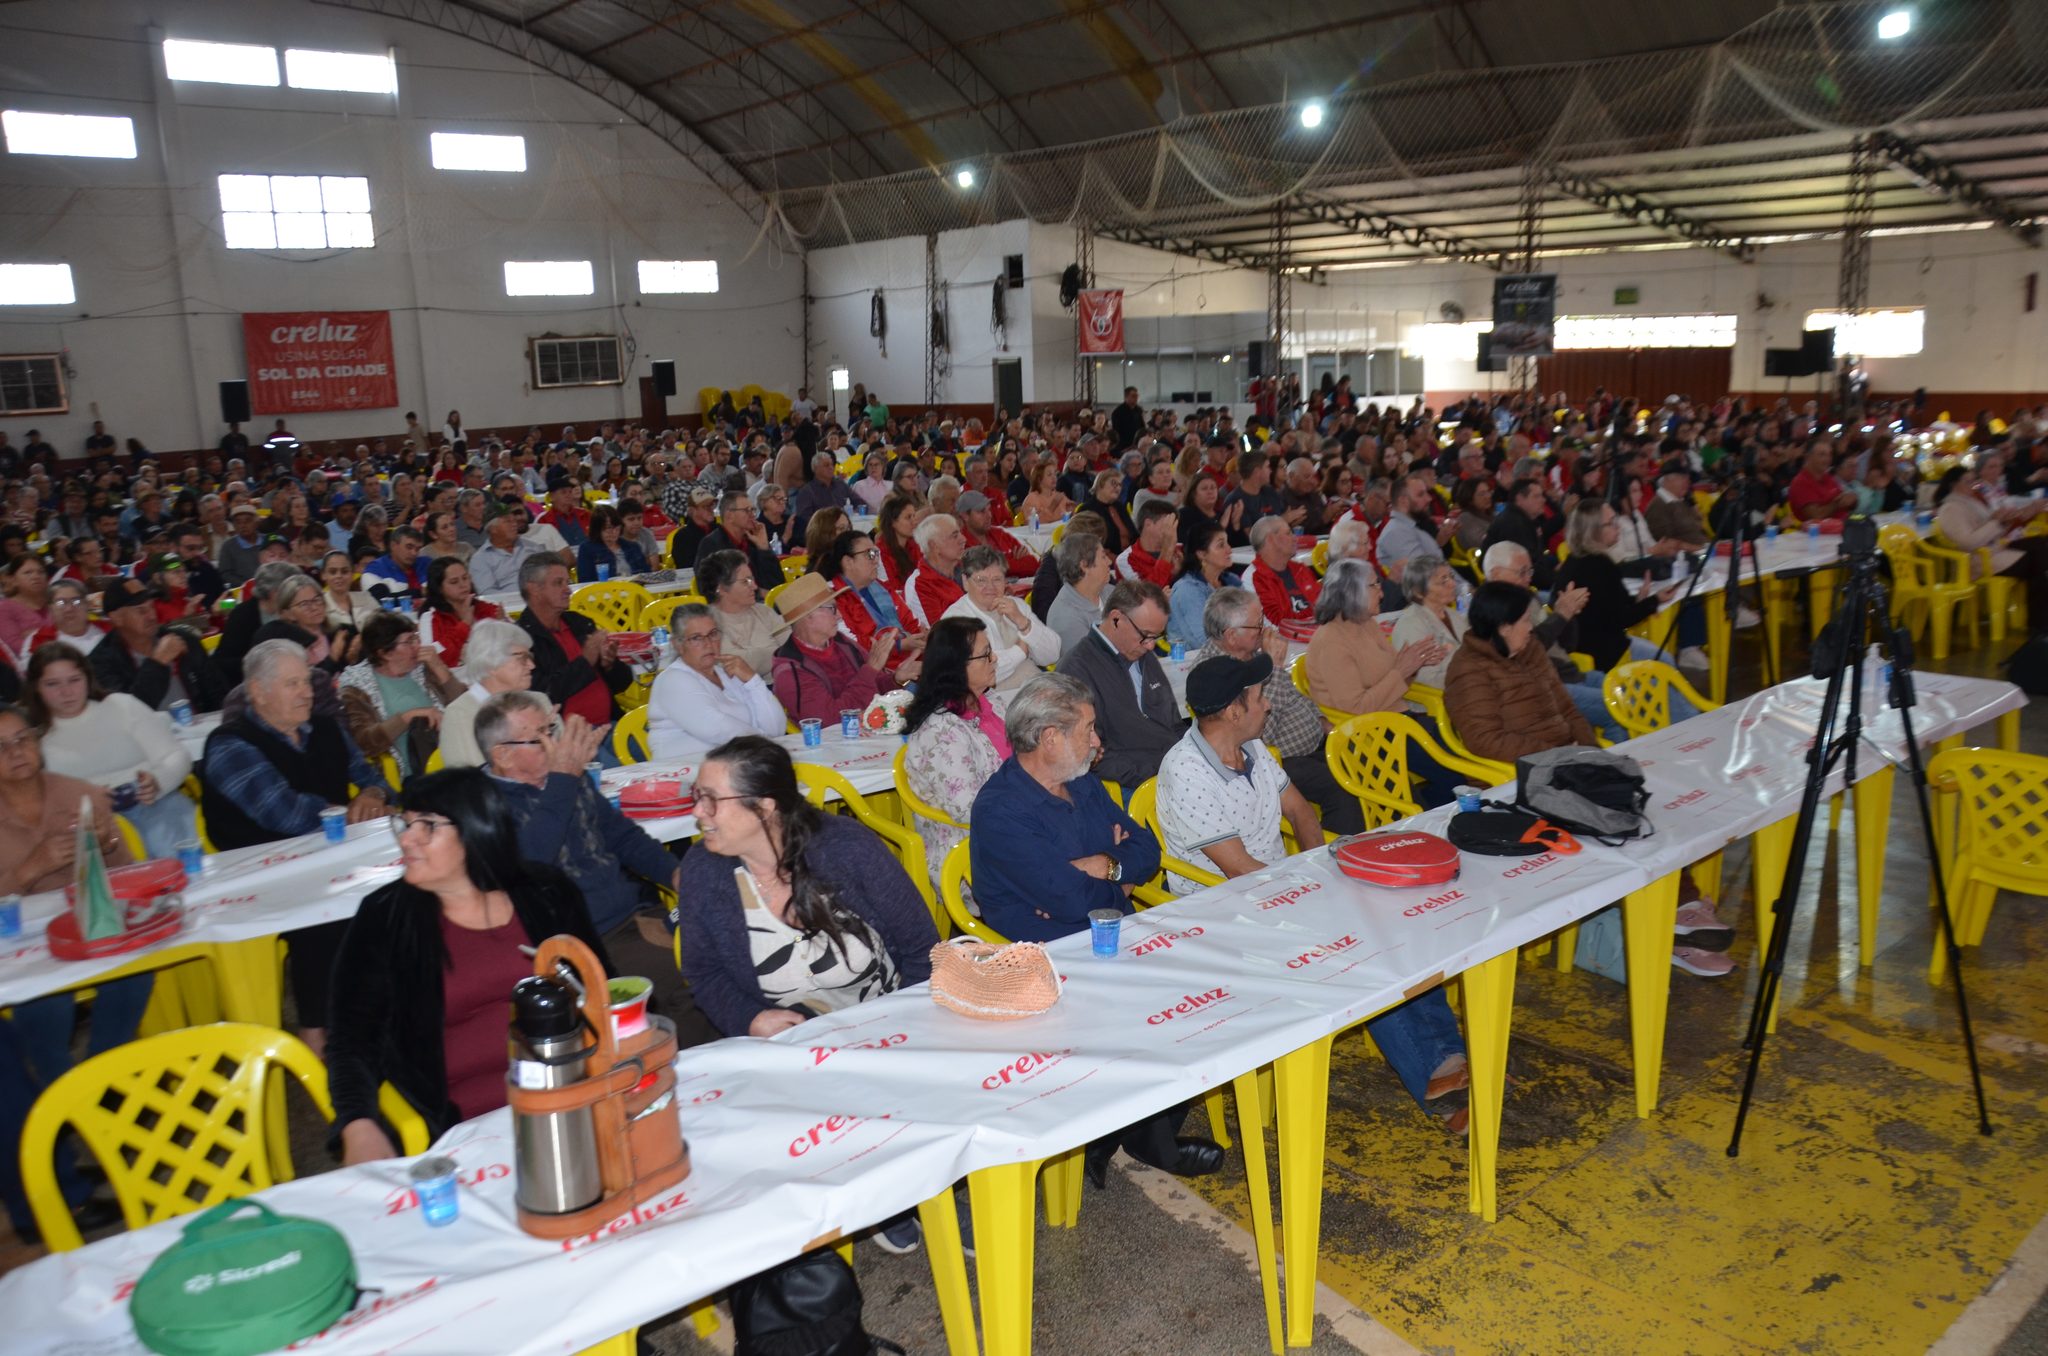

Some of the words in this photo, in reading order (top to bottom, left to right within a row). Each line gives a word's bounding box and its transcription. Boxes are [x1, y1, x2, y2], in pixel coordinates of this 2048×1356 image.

[270, 318, 358, 344] creluz
[276, 351, 319, 362] USINA
[321, 348, 367, 361] SOLAR
[257, 368, 292, 381] SOL
[296, 366, 321, 379] DA
[324, 363, 388, 378] CIDADE
[1664, 789, 1708, 810] creluz
[1379, 838, 1426, 852] creluz
[1502, 853, 1557, 879] creluz
[1258, 882, 1322, 911] creluz
[1403, 889, 1465, 918] creluz
[1130, 926, 1205, 957] creluz
[1286, 934, 1358, 970] creluz
[1146, 987, 1231, 1026] creluz
[216, 1250, 302, 1287] Sicredi
